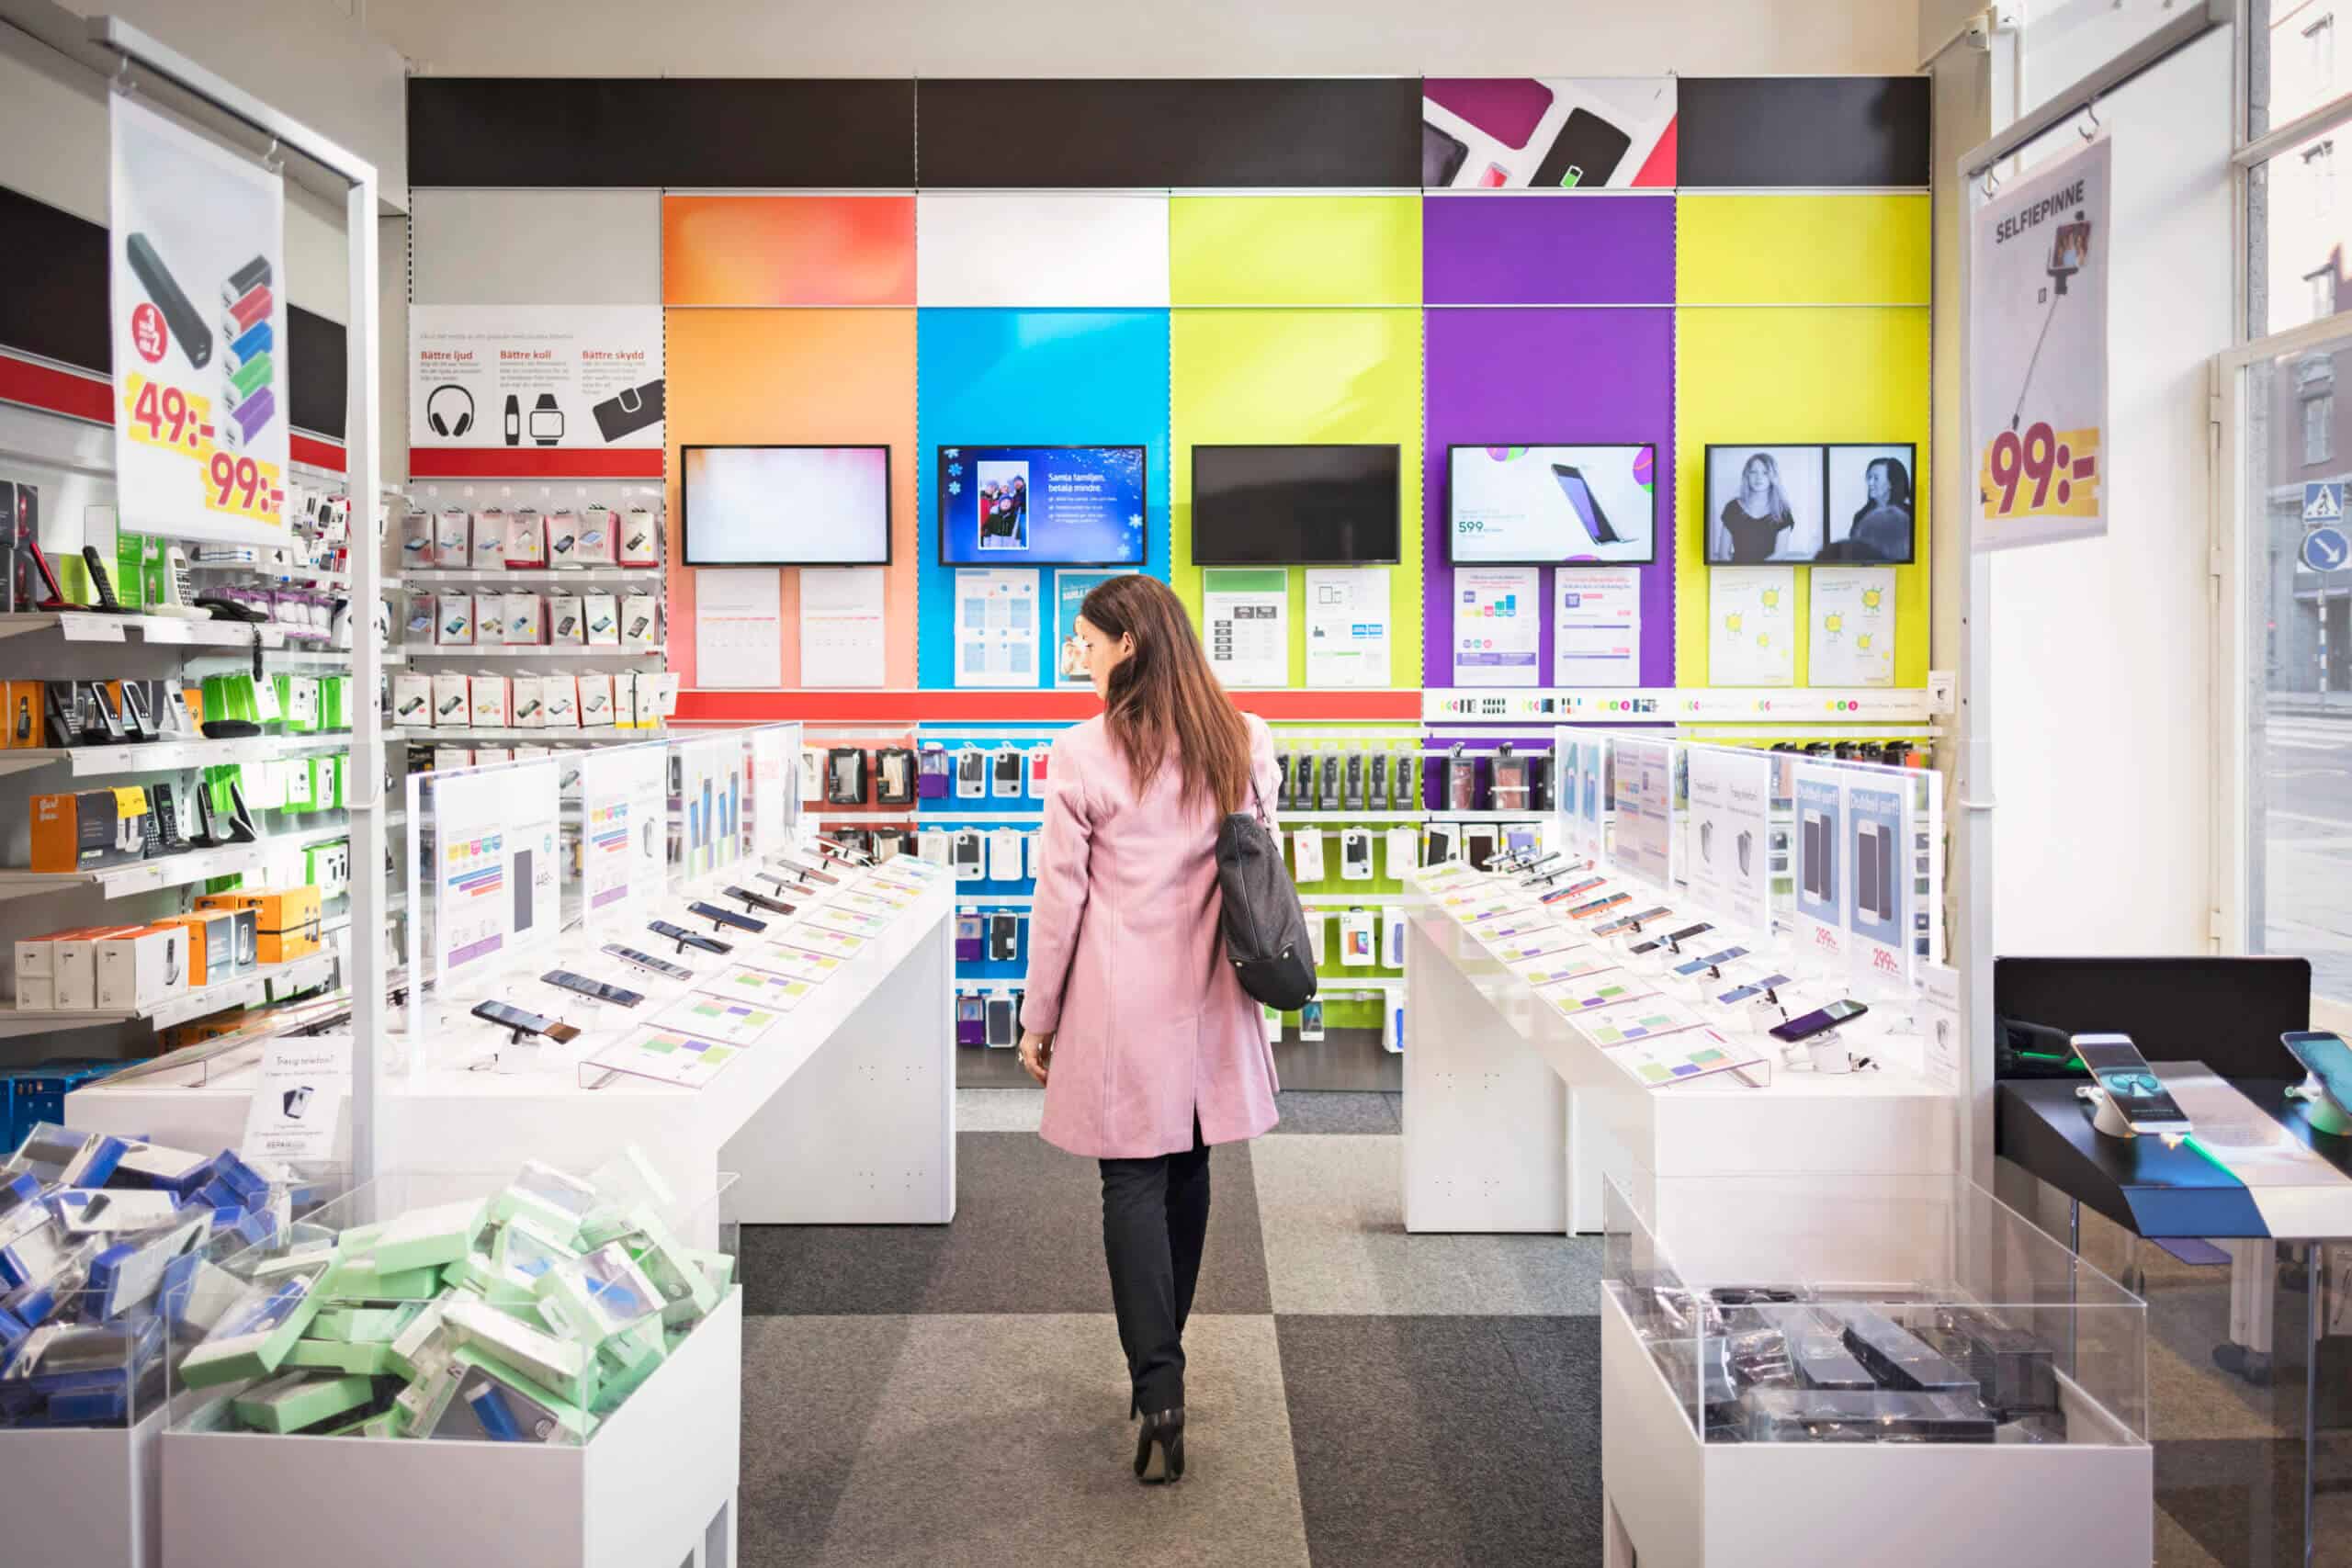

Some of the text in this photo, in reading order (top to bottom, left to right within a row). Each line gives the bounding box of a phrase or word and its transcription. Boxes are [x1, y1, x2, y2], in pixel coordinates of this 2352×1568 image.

[1996, 179, 2086, 244] SELFIEPINNE
[420, 350, 473, 361] Bättre ljud
[500, 349, 552, 359] Bättre koll
[582, 349, 645, 361] Bättre skydd
[134, 381, 216, 448] 49:-
[210, 451, 285, 513] 99:-
[1989, 421, 2096, 514] 99:-
[1458, 521, 1484, 533] 599
